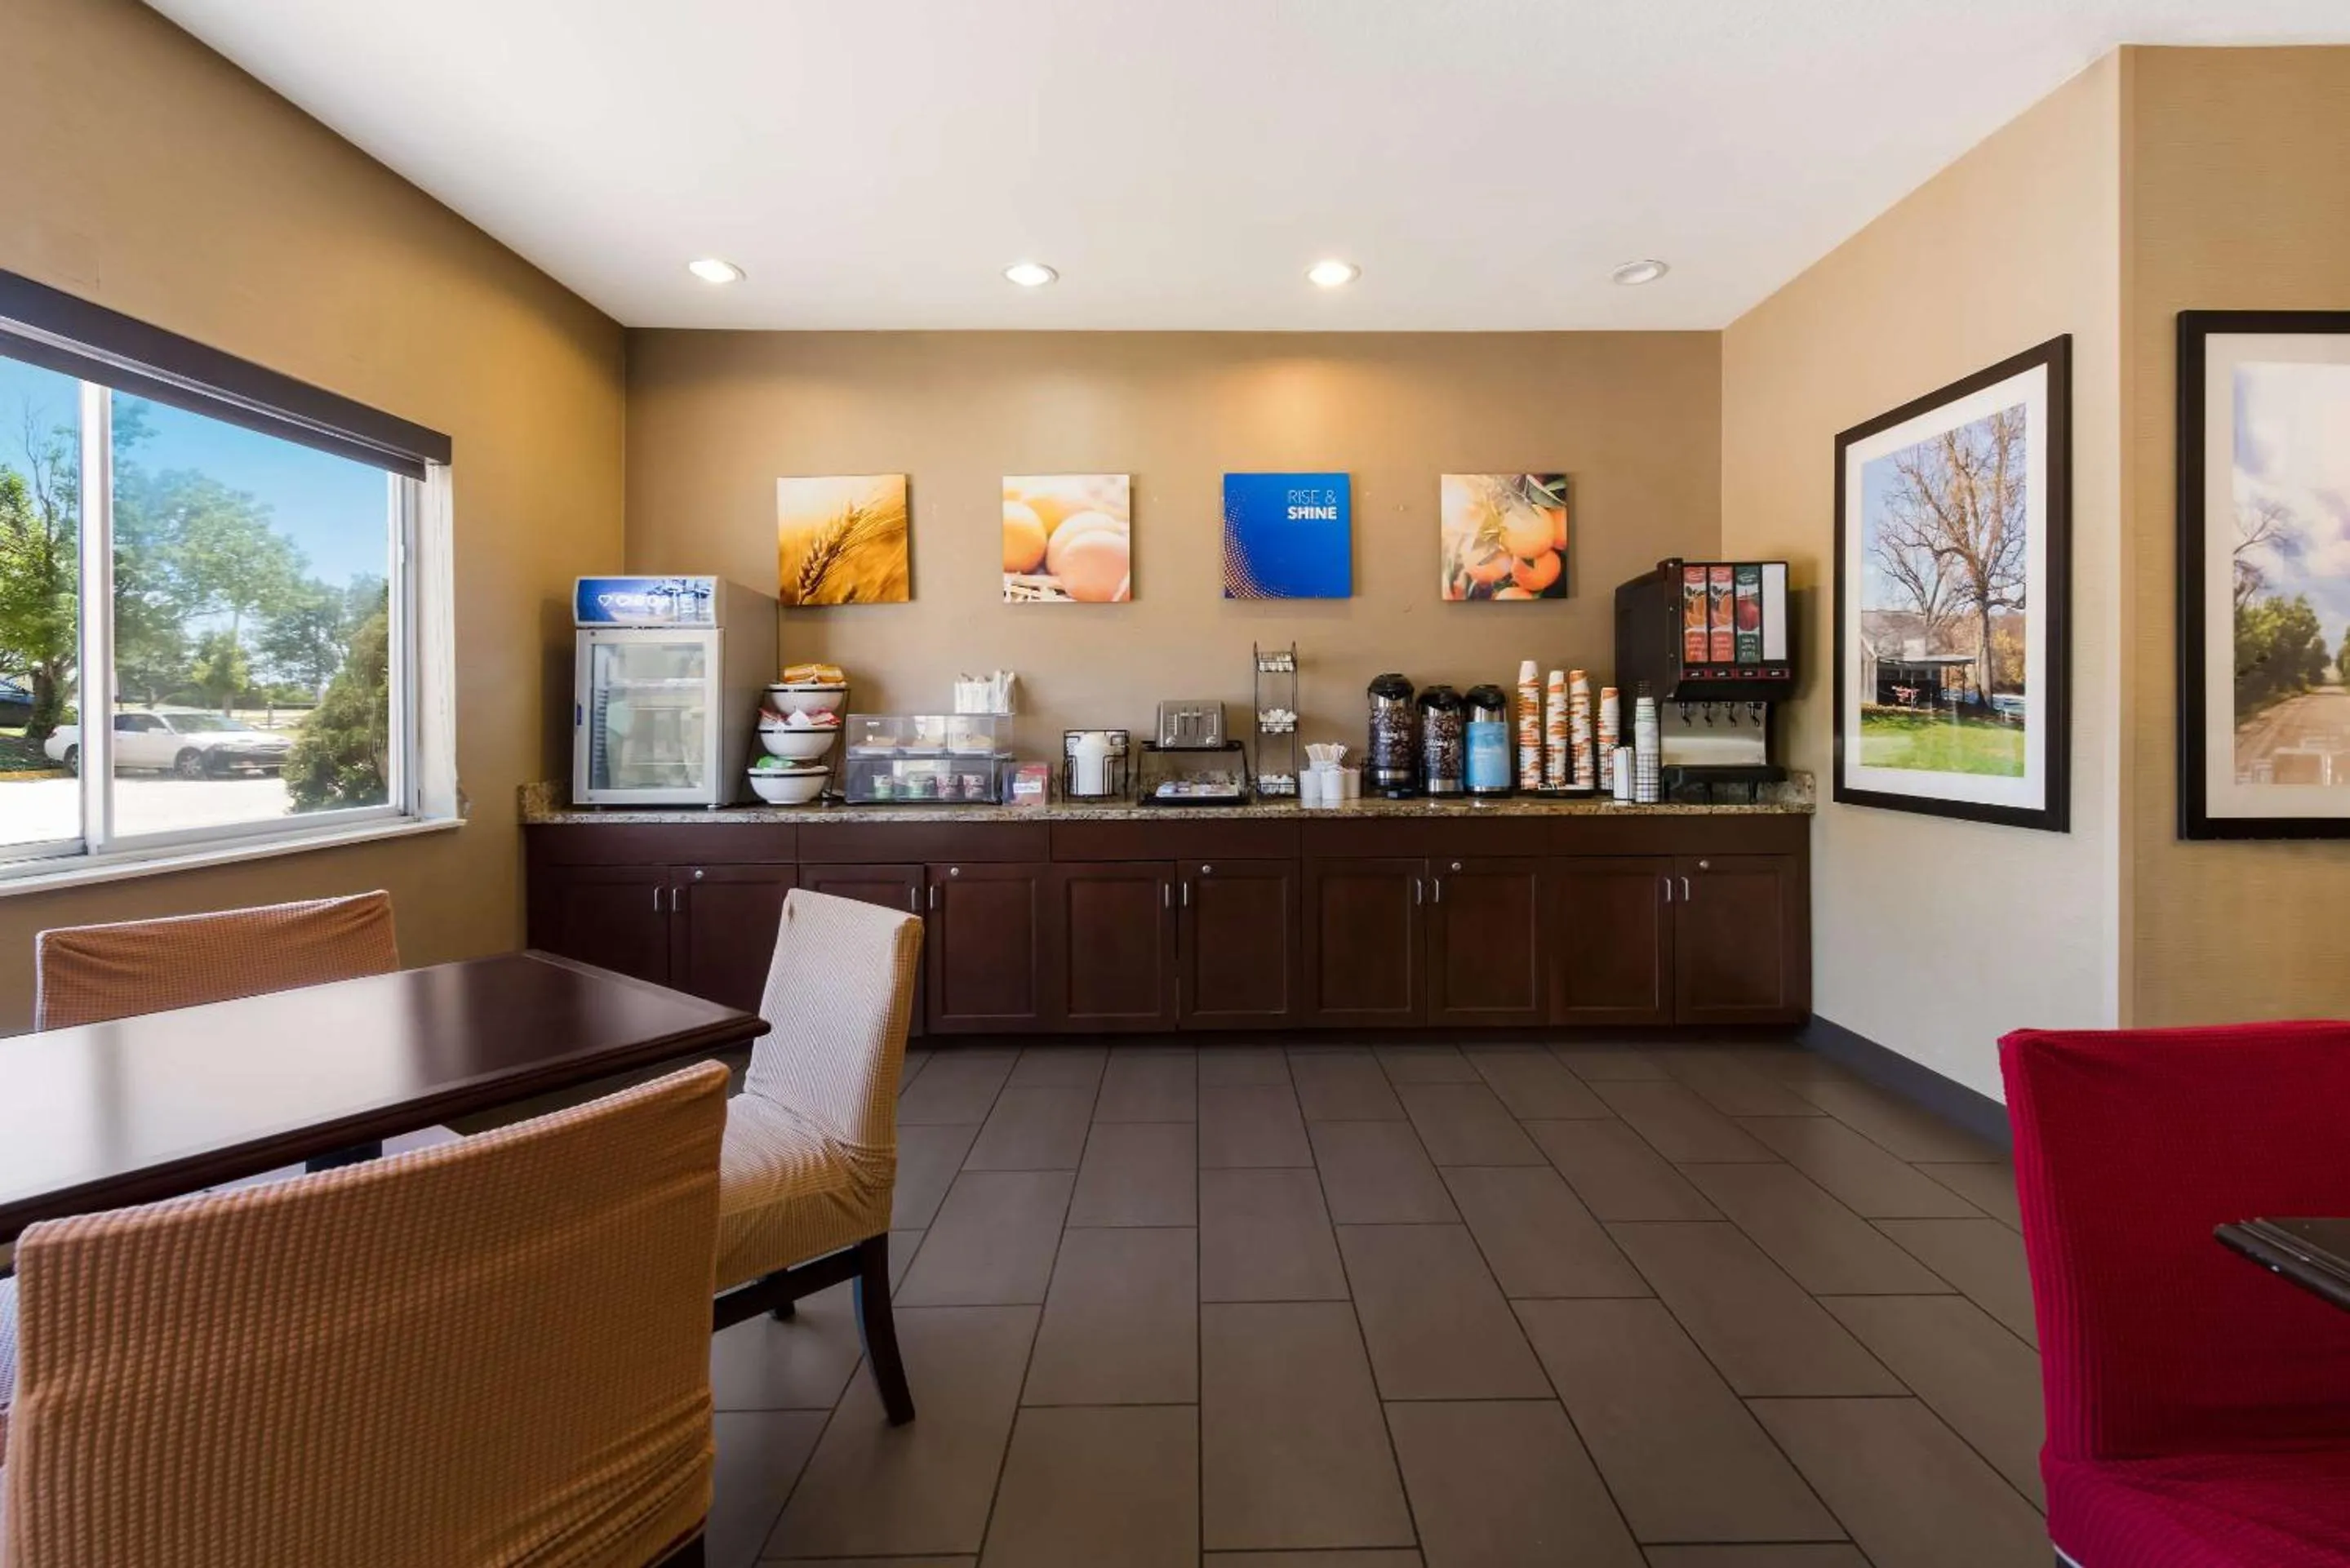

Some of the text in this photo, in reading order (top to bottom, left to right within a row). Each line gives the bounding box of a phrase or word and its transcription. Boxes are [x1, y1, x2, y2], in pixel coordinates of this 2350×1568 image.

[1288, 490, 1336, 504] RISE &
[1287, 506, 1337, 520] SHINE
